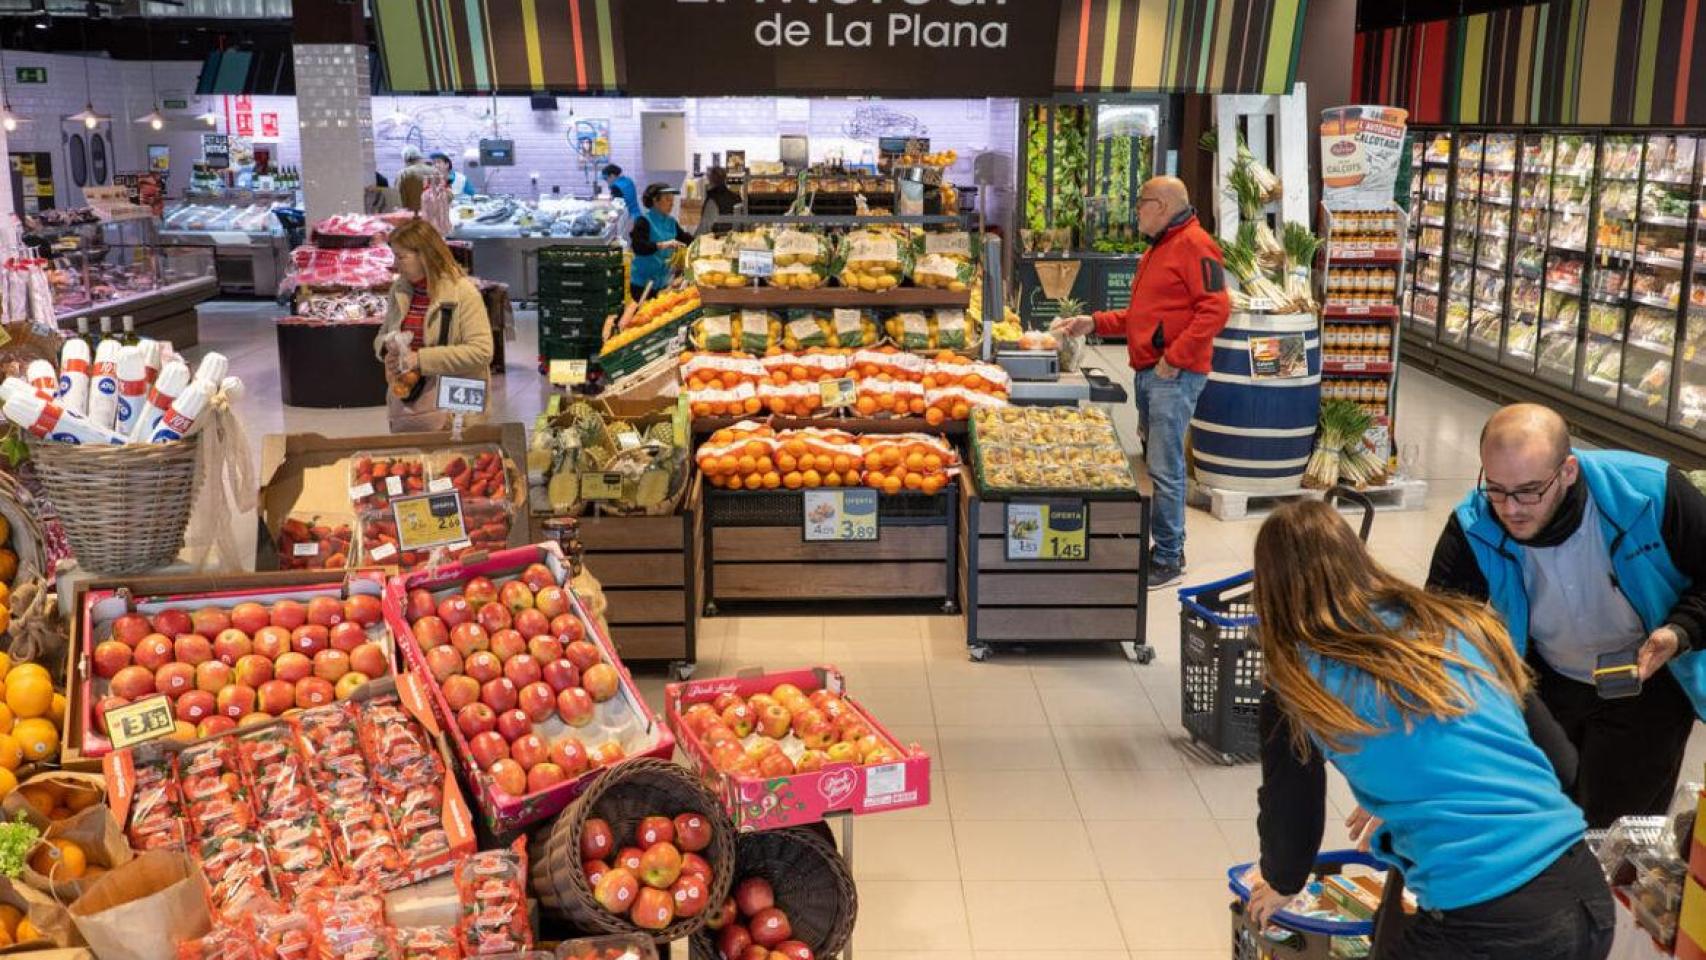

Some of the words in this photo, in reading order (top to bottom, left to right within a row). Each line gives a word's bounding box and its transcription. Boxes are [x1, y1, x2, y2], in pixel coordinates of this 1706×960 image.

[755, 12, 811, 46] de
[825, 12, 872, 46] La
[887, 12, 1008, 47] Plana
[1051, 511, 1081, 519] OFERTA
